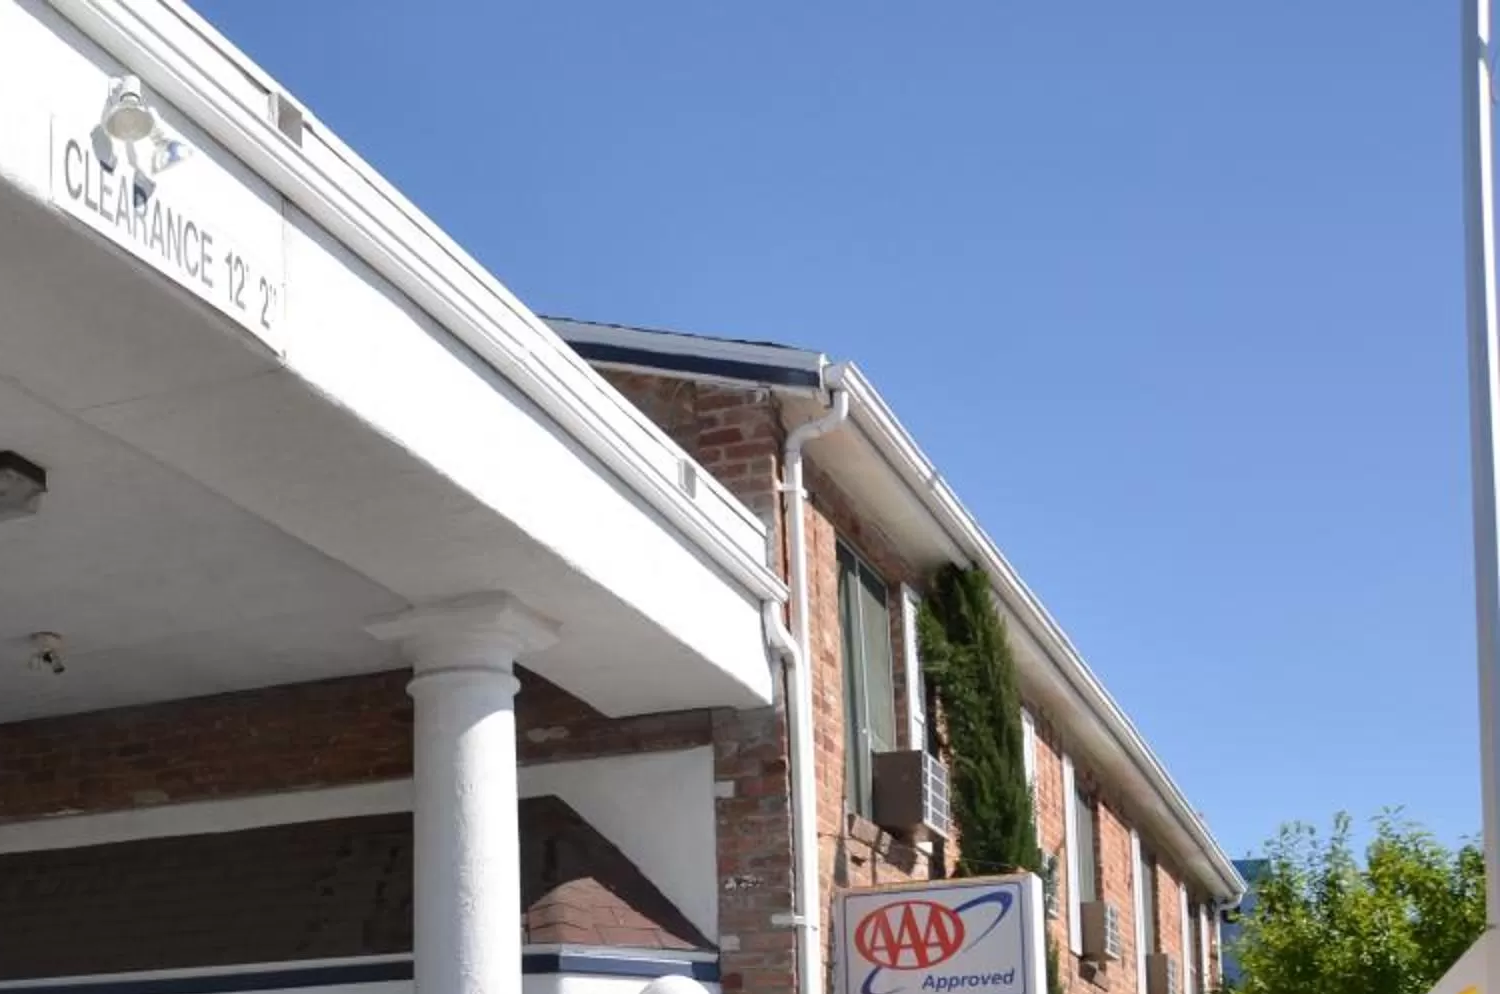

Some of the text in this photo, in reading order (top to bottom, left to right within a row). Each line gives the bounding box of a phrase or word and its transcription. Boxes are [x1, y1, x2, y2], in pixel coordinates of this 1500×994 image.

[64, 138, 213, 288] CLEARANCE
[869, 901, 954, 968] AAA
[922, 968, 1015, 992] Approved
